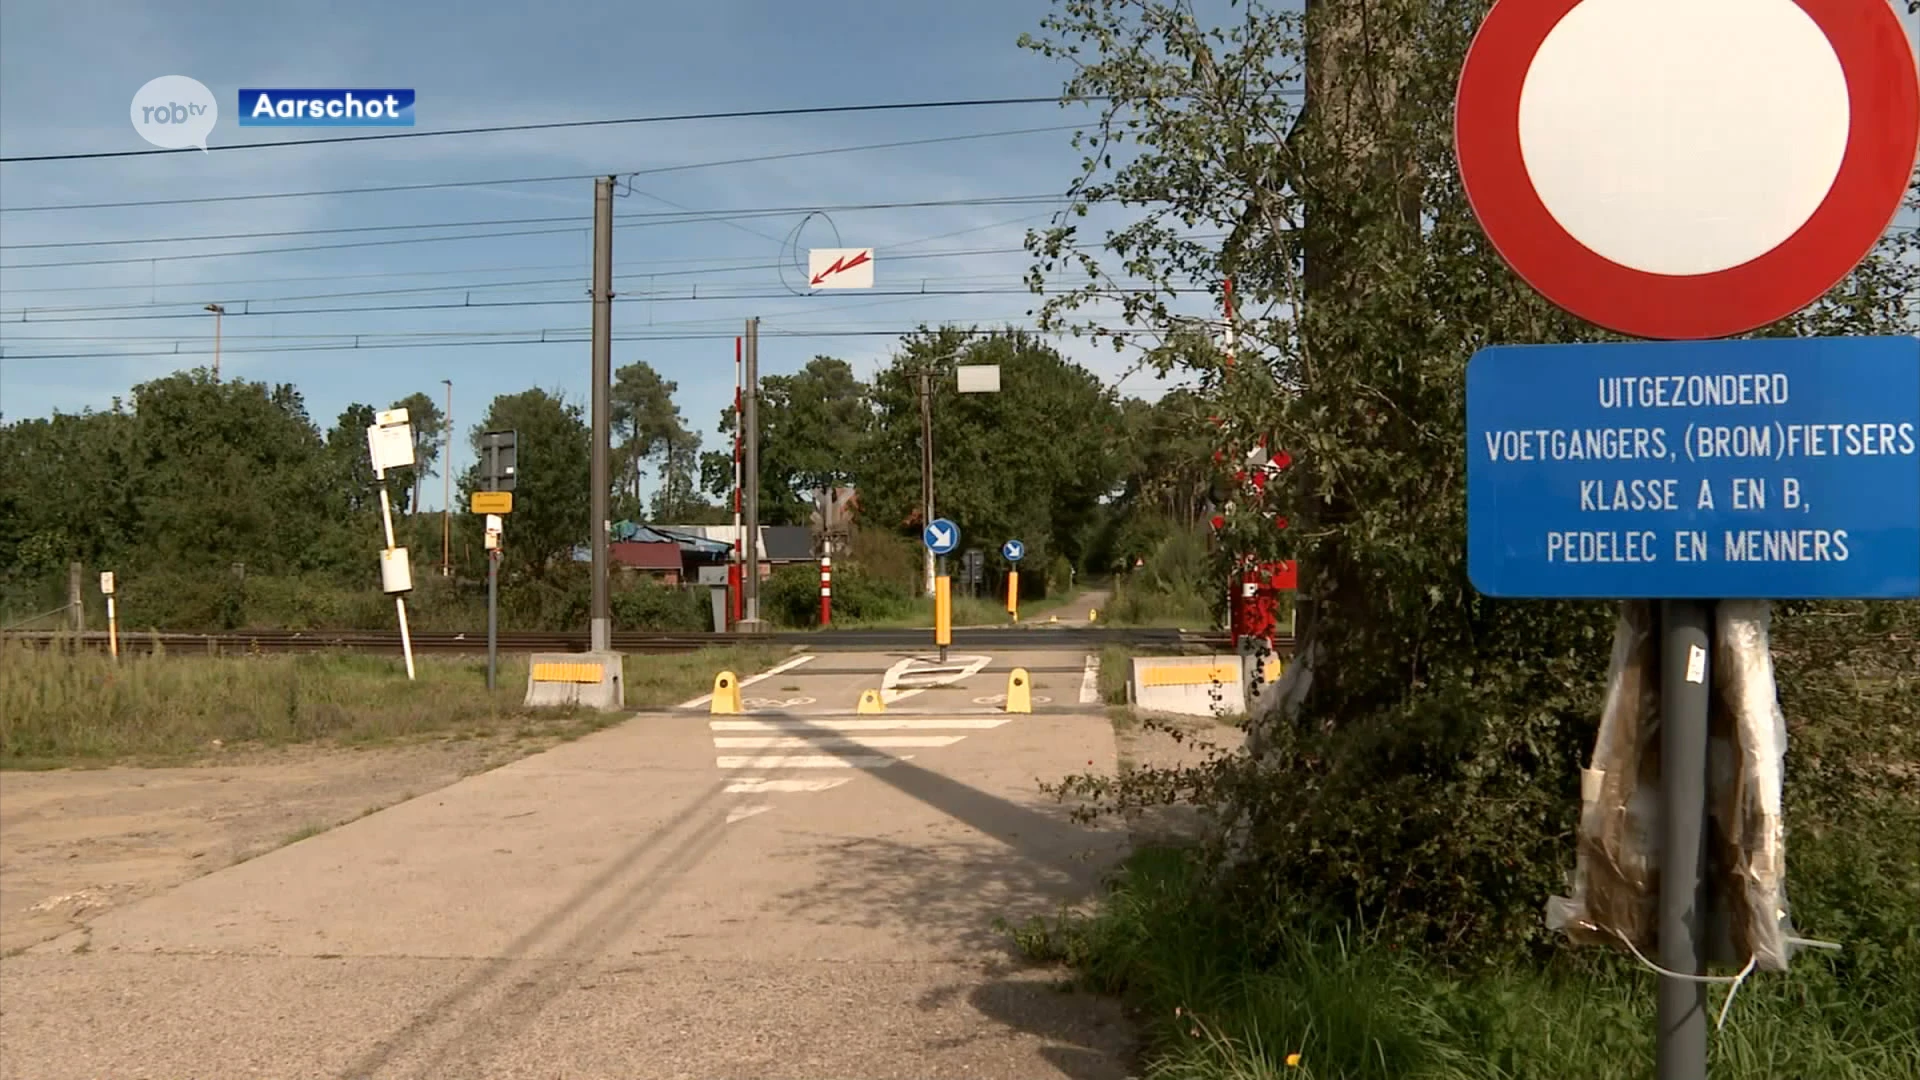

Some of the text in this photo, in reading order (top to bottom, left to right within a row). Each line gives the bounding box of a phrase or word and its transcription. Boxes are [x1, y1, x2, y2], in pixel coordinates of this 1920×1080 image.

[1598, 373, 1789, 408] UITGEZONDERD
[1485, 422, 1915, 463] VOETGANGERS, (BROM)FIETSERS
[1580, 478, 1811, 513] KLASSE A EN B,
[1547, 529, 1850, 563] PEDELEC EN MENNERS
